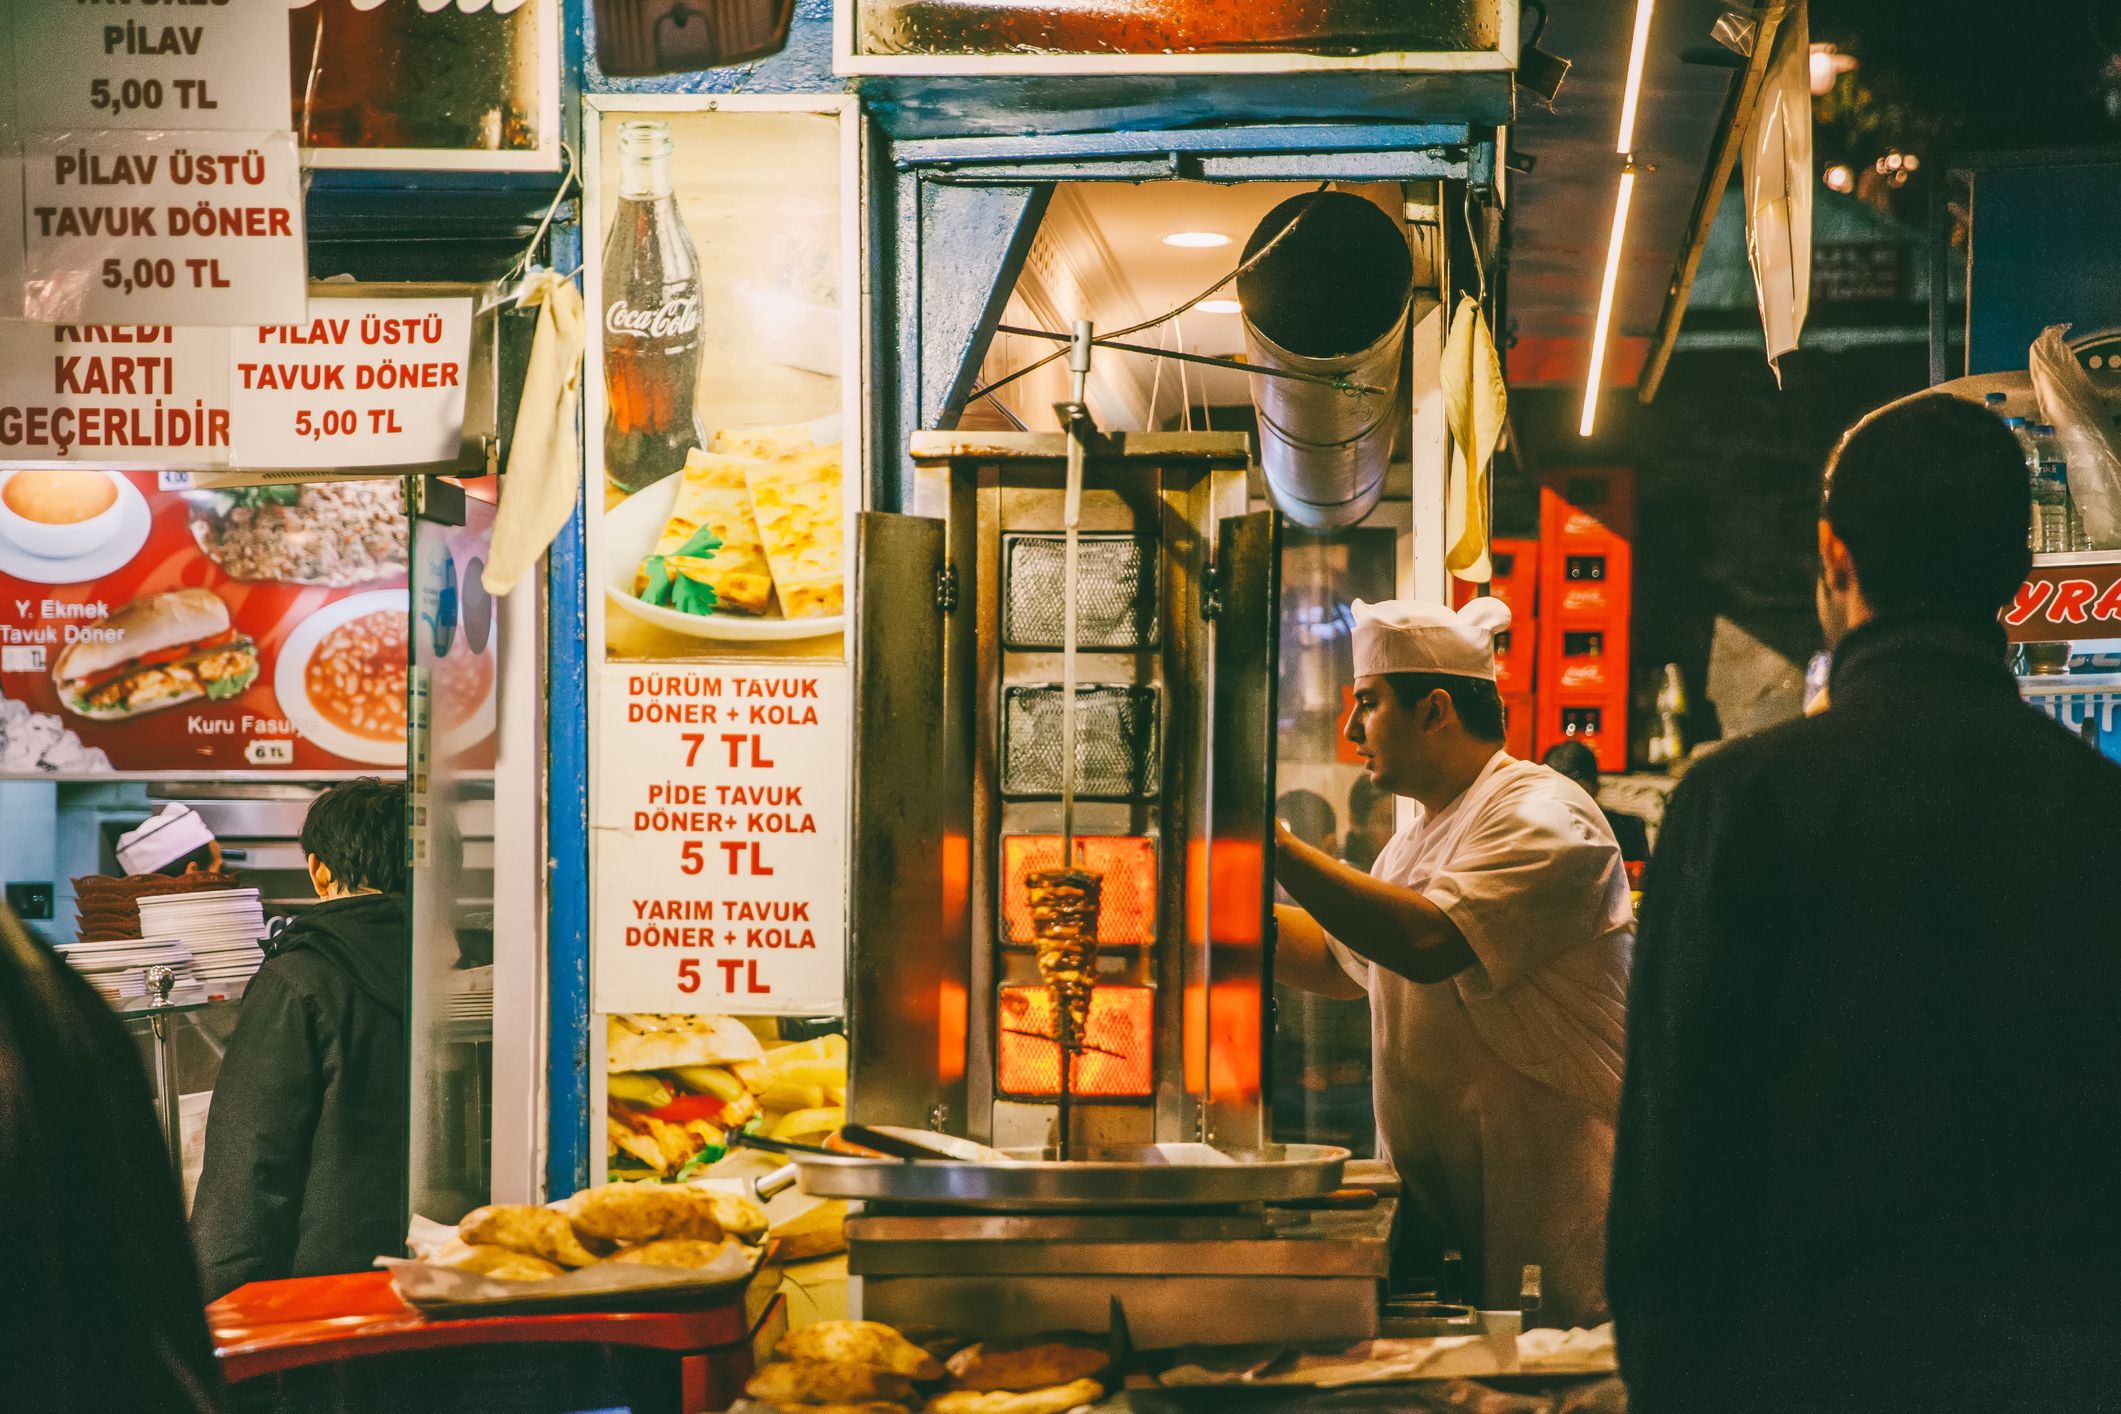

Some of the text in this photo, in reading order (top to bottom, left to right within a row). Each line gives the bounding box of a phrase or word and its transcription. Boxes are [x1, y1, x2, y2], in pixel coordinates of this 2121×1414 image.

[104, 19, 203, 55] PİLAV
[90, 78, 217, 115] 5,00 TL
[55, 149, 265, 185] PİLAV ÜSTÜ
[34, 201, 292, 236] TAVUK DÖNER
[102, 258, 230, 295] 5,00 TL
[361, 313, 443, 344] ÜSTÜ
[606, 295, 699, 338] Coca-Cola
[55, 356, 173, 394] KARTI
[238, 359, 459, 390] TAVUK DÖNER
[0, 399, 230, 456] GEÇERLİDİR
[295, 409, 403, 441] 5,00 TL
[15, 599, 109, 619] Y. Ekmek
[0, 624, 126, 644] Tavuk Döner
[628, 672, 819, 699] DÜRÜM TAVUK
[187, 715, 235, 735] Kuru
[628, 699, 819, 726] DÖNER + KOLA
[255, 745, 266, 758] 6
[681, 733, 774, 768] 7 TL
[648, 780, 802, 806] PİDE TAVUK
[747, 813, 817, 834] KOLA
[680, 840, 774, 876] 5 TL
[632, 900, 810, 922] YARIM TAVUK
[625, 923, 816, 949] DÖNER + KOLA
[676, 958, 771, 994] 5 TL
